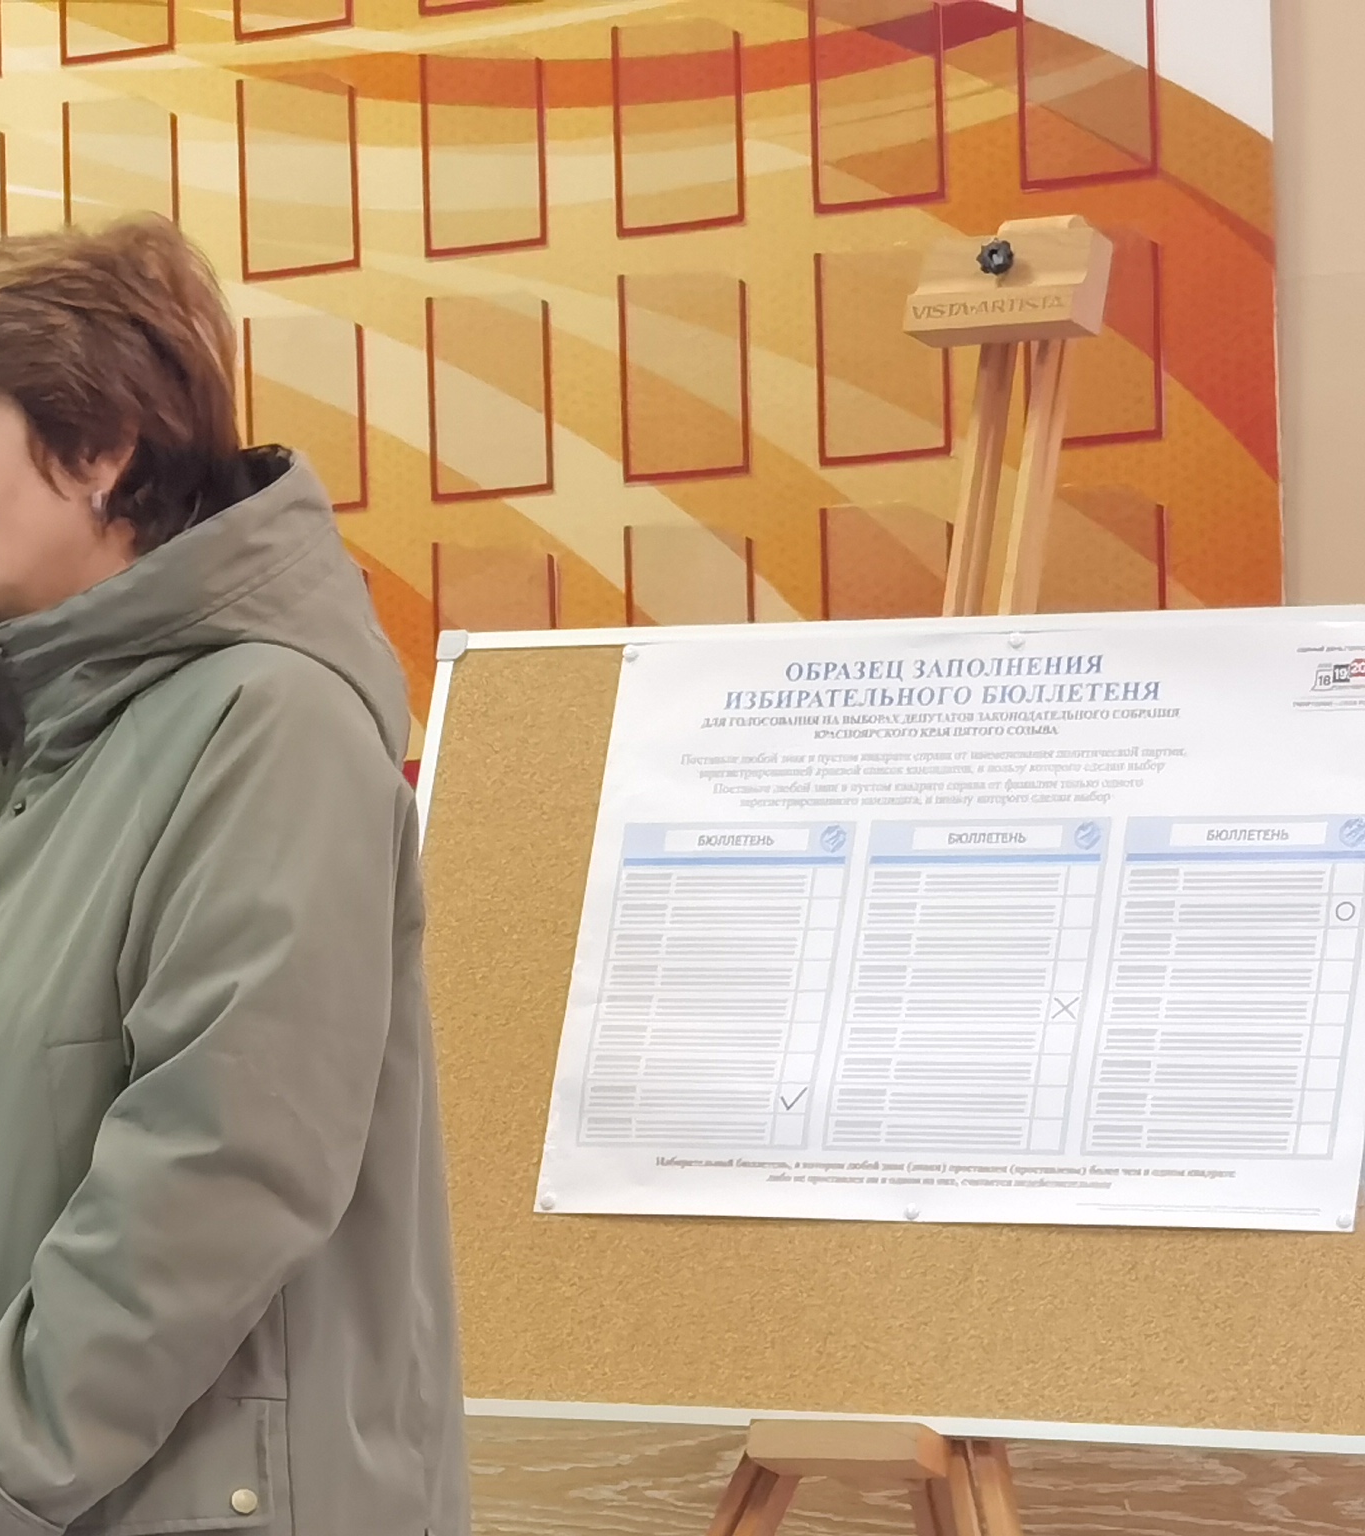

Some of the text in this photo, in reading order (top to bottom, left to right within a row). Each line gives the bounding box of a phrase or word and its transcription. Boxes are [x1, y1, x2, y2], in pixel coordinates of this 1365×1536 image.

[785, 654, 1104, 682] ОБРАЗЕЦ ЗАПОЛНЕНИЯ
[1334, 668, 1348, 681] 19
[1318, 674, 1332, 687] 18
[723, 680, 1161, 711] ИЗБИРАТЕЛЬНОГО БЮЛЛЕТЕНЯ
[842, 714, 899, 725] ВЫБОРАХ
[978, 709, 1109, 723] ЗАКОНОДАТЕЛЬНОГО
[697, 834, 775, 847] БЮЛЛЕТЕНЬ
[947, 832, 1027, 845] БЮЛЛЕТЕНЬ
[1206, 828, 1289, 842] БЮЛЛЕТЕНЬ
